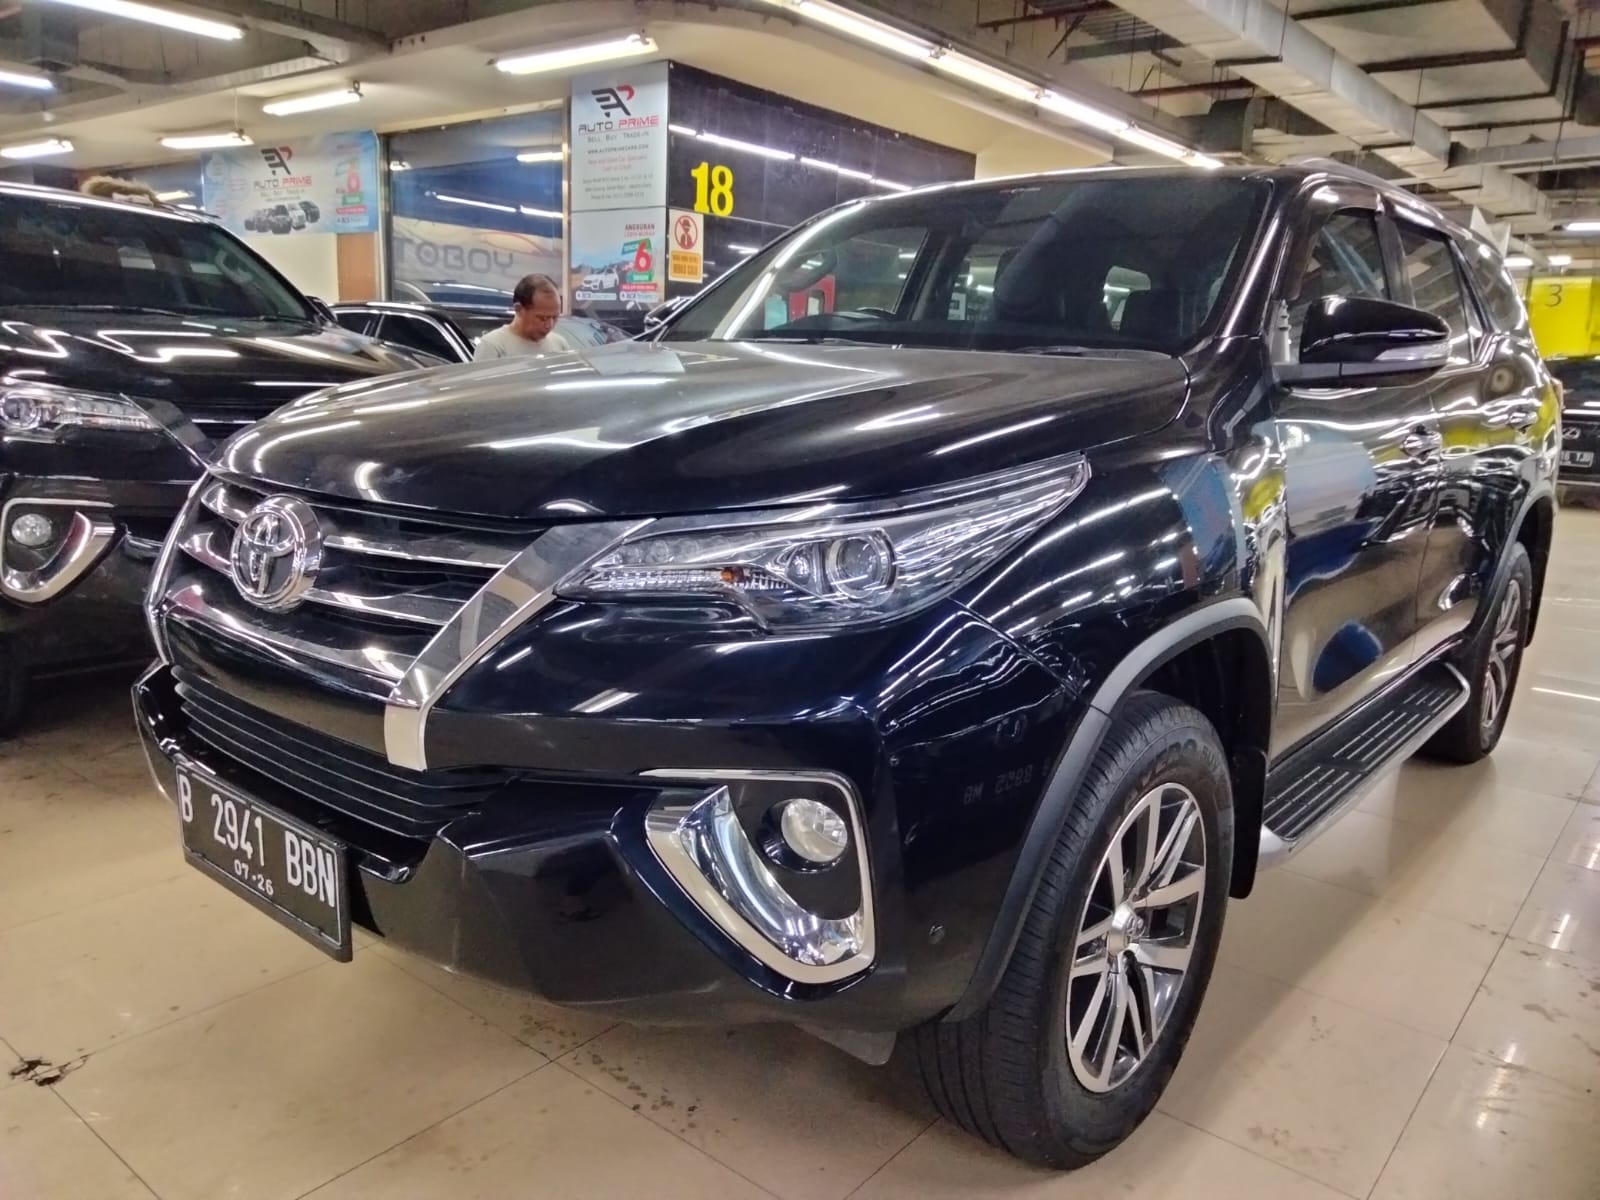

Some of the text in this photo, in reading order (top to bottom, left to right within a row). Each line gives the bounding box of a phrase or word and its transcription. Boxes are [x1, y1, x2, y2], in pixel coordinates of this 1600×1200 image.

[578, 115, 659, 133] AUTO PRIME
[282, 176, 312, 187] PRIME
[691, 162, 734, 217] 18
[634, 239, 651, 273] 6
[1544, 283, 1562, 308] 3
[178, 773, 335, 908] B 2941 BBN
